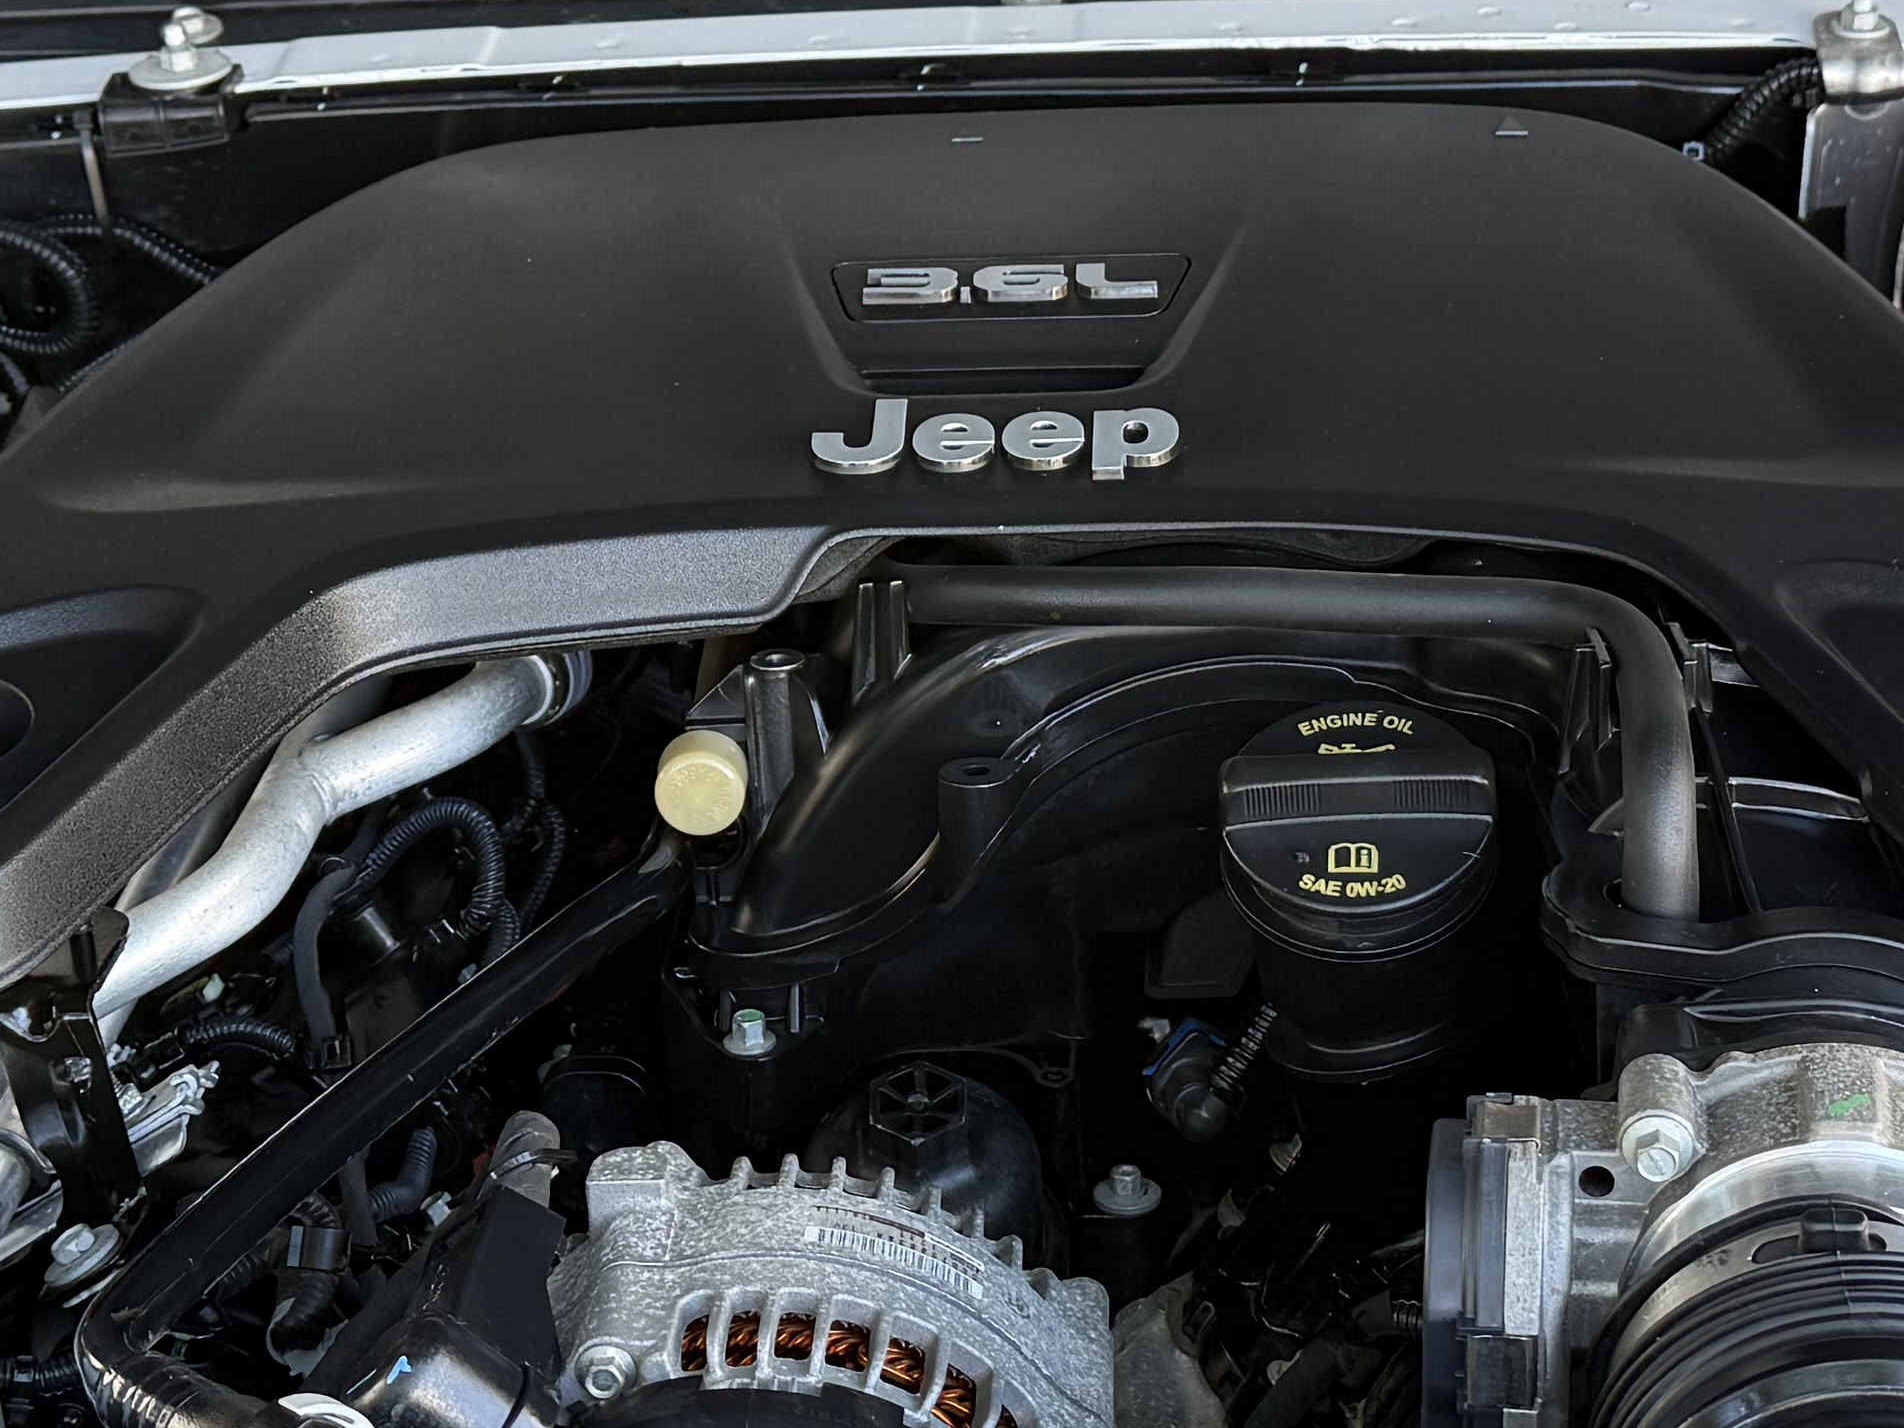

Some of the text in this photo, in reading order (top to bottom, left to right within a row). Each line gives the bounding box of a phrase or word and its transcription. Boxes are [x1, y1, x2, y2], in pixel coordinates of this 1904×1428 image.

[862, 263, 1158, 304] 3.6L
[811, 399, 1179, 480] Jeep
[1298, 710, 1415, 737] ENGINE OIL
[1299, 873, 1407, 899] SAE 0W-20
